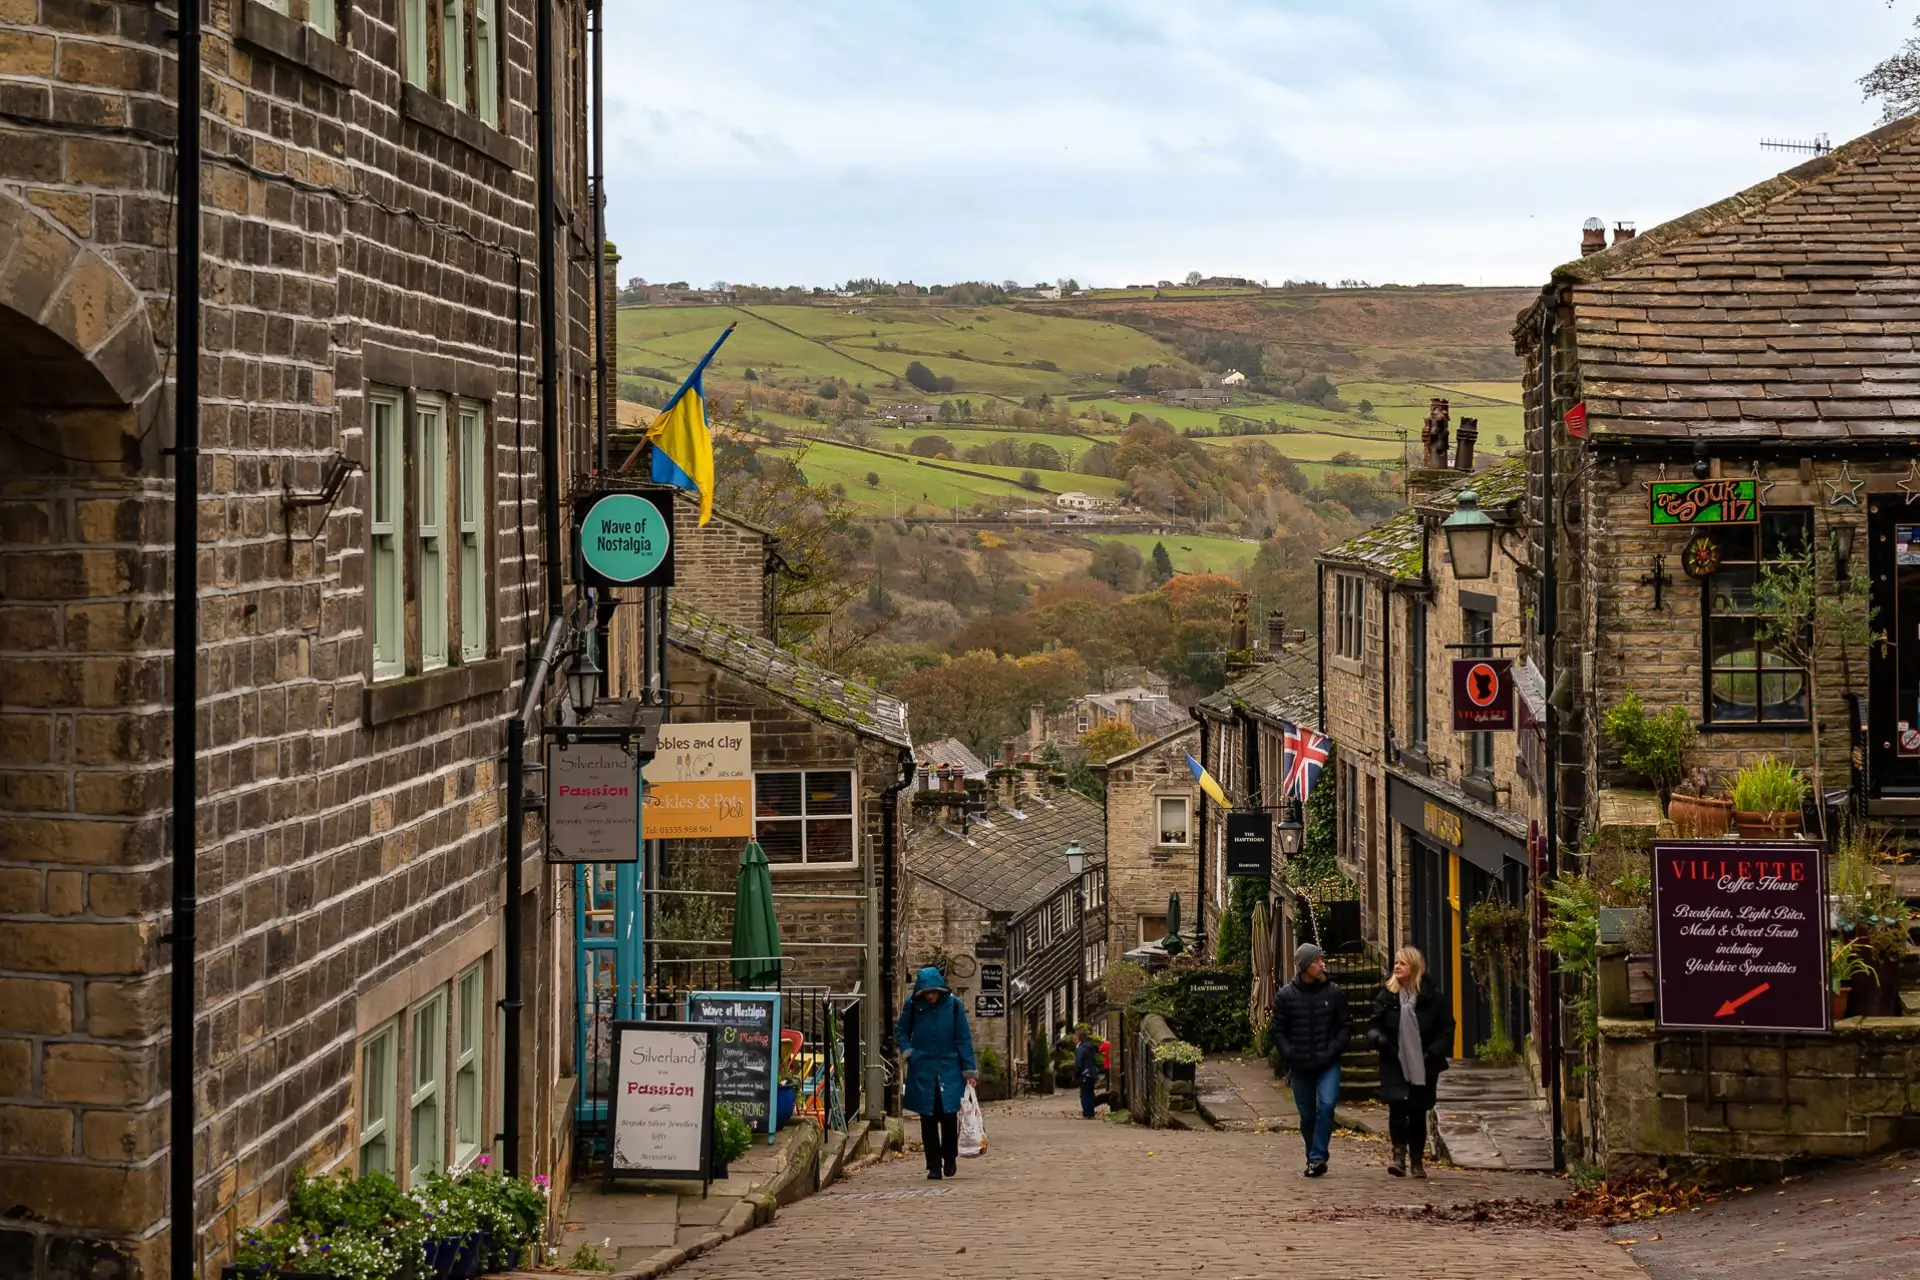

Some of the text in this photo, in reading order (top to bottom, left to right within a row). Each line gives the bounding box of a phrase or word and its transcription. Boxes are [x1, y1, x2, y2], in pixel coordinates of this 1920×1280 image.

[1657, 493, 1677, 507] The
[1722, 499, 1752, 521] 117
[601, 518, 647, 534] Wave of
[597, 536, 652, 554] Nostalgia
[656, 736, 690, 750] bbles
[693, 737, 715, 749] and
[559, 752, 628, 773] Silverland
[559, 784, 629, 797] Passion
[696, 794, 711, 809] &
[644, 825, 713, 835] Tel: 01535 958 961
[1672, 860, 1805, 881] VILLETTE
[1717, 875, 1799, 893] Coffee House
[1736, 905, 1772, 922] Light
[1680, 923, 1799, 938] Meals & Sweet Treats
[1716, 942, 1763, 957] including
[1685, 957, 1797, 976] Yorkshire Specialities
[702, 1004, 724, 1016] Wave
[630, 1046, 697, 1066] Silverland
[627, 1081, 695, 1097] Passion
[621, 1119, 647, 1128] Bespoke
[668, 1120, 699, 1130] Jewellery
